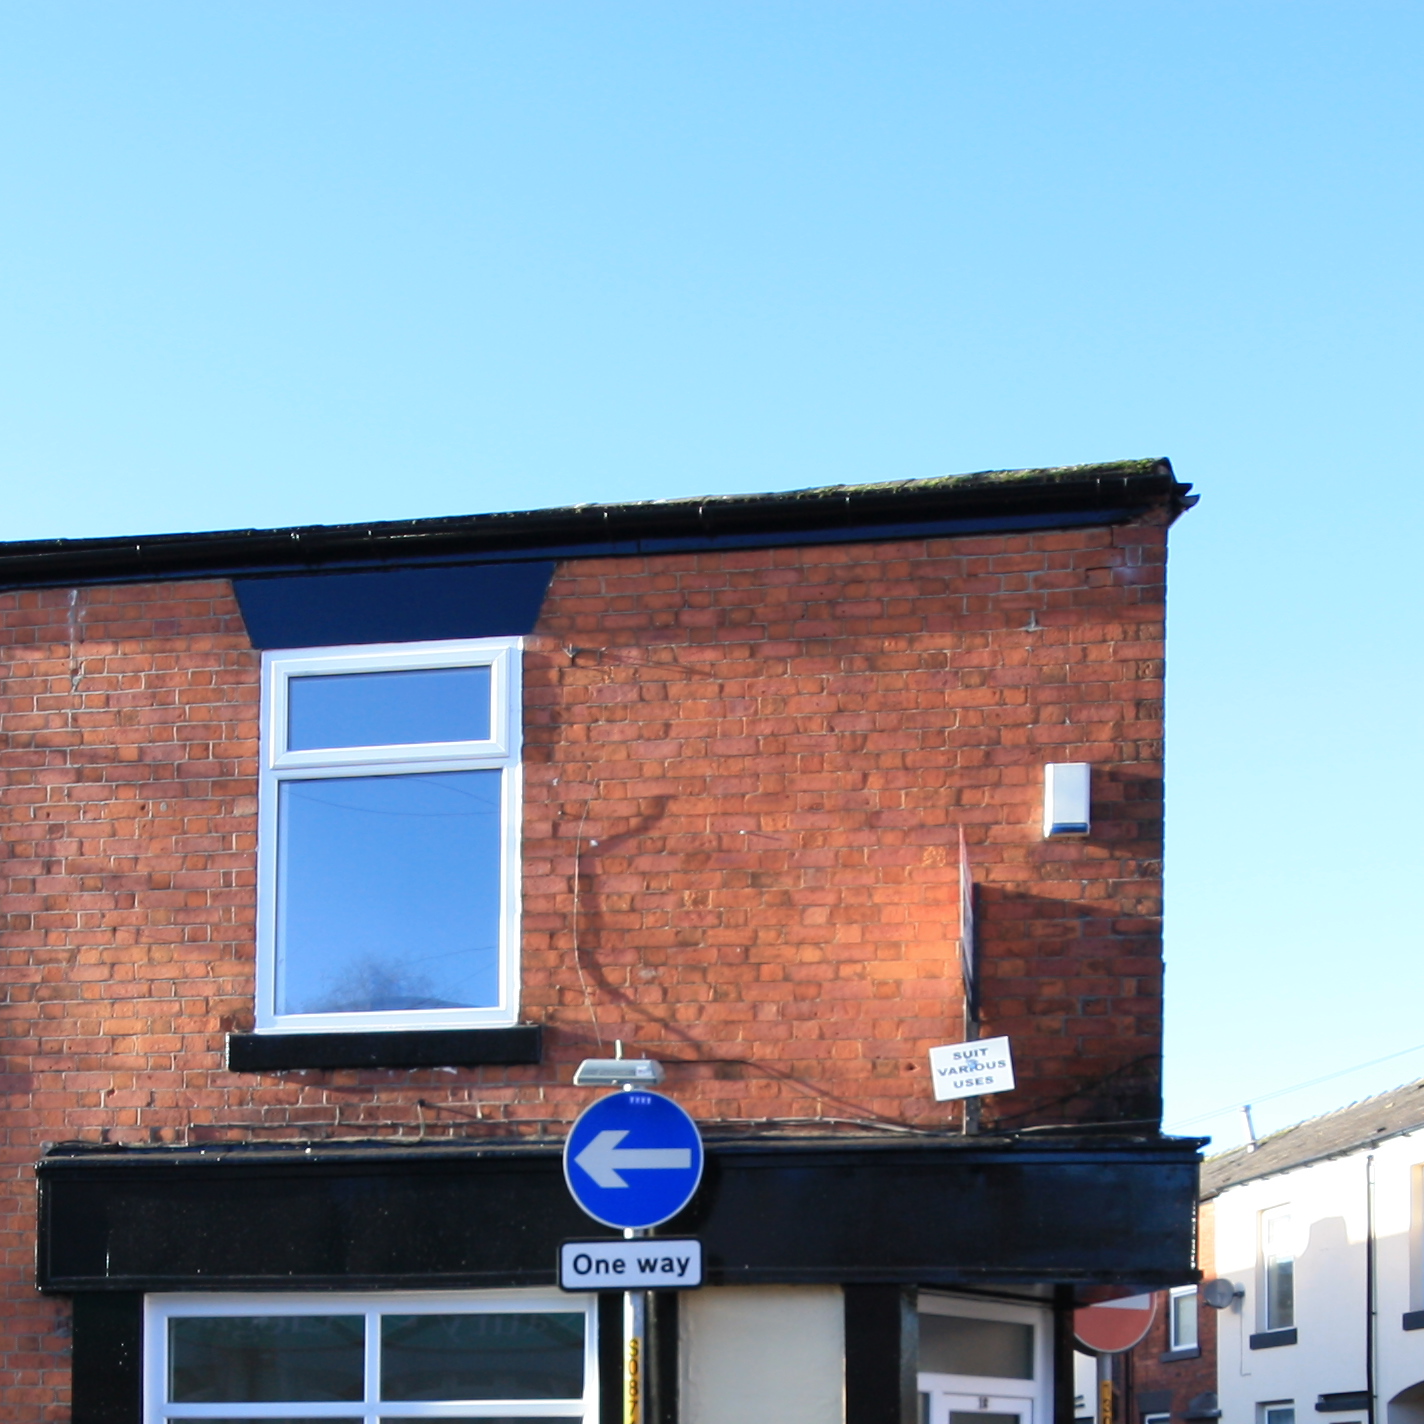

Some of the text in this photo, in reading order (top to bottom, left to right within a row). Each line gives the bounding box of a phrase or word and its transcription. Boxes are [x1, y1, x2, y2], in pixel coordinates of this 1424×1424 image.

[953, 1047, 988, 1061] SUIT
[937, 1060, 1007, 1077] VARIOUS
[953, 1076, 994, 1089] USES
[573, 1253, 690, 1277] One way
